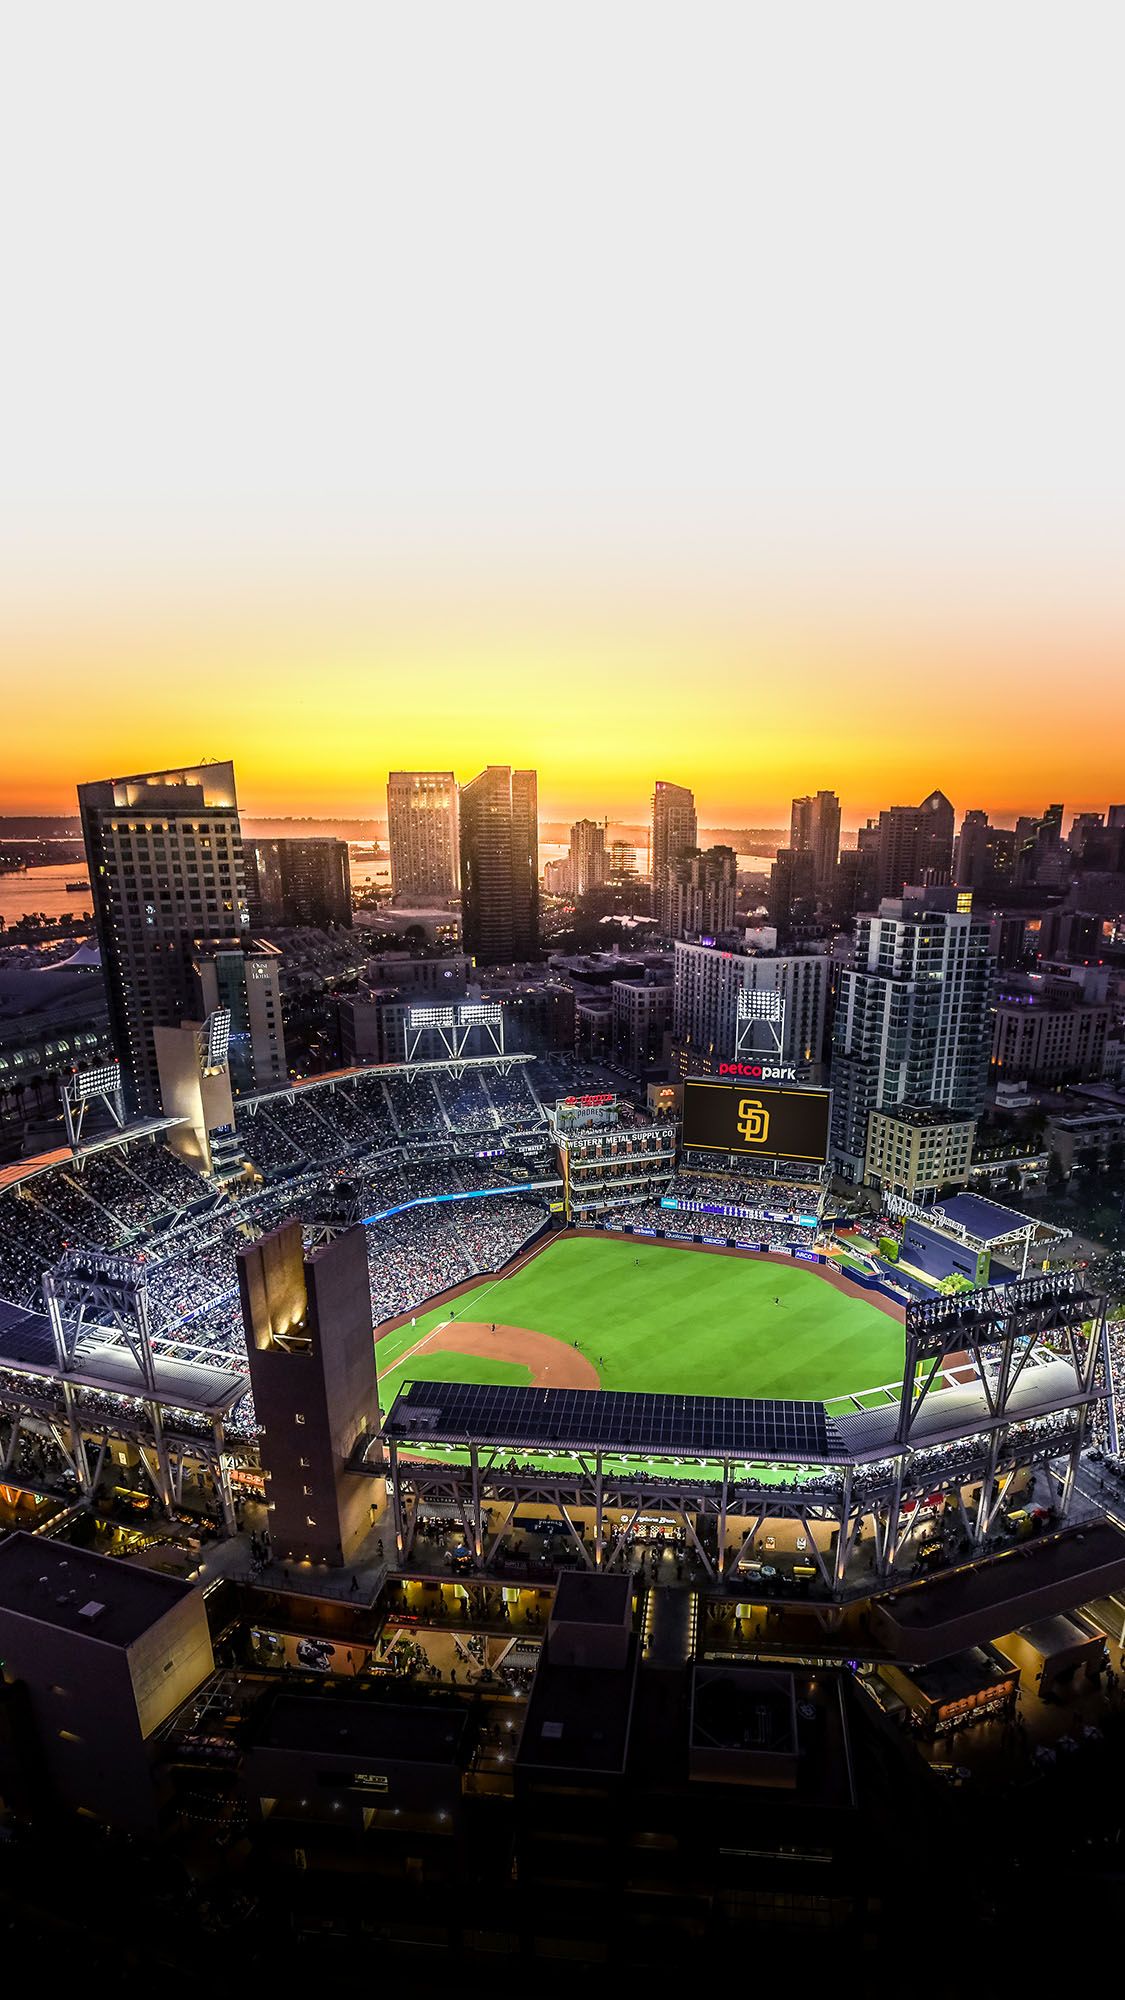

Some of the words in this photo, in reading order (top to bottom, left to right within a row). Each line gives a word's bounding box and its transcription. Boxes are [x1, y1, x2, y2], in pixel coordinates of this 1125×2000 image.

[581, 1094, 613, 1102] TOYOTA
[577, 1108, 604, 1119] PADRES
[737, 1099, 770, 1143] SD
[568, 1138, 603, 1148] WESTERN
[606, 1133, 630, 1144] METAL
[631, 1131, 660, 1141] SUPPLY
[703, 1237, 726, 1245] GEICO
[795, 1251, 812, 1260] ARCO
